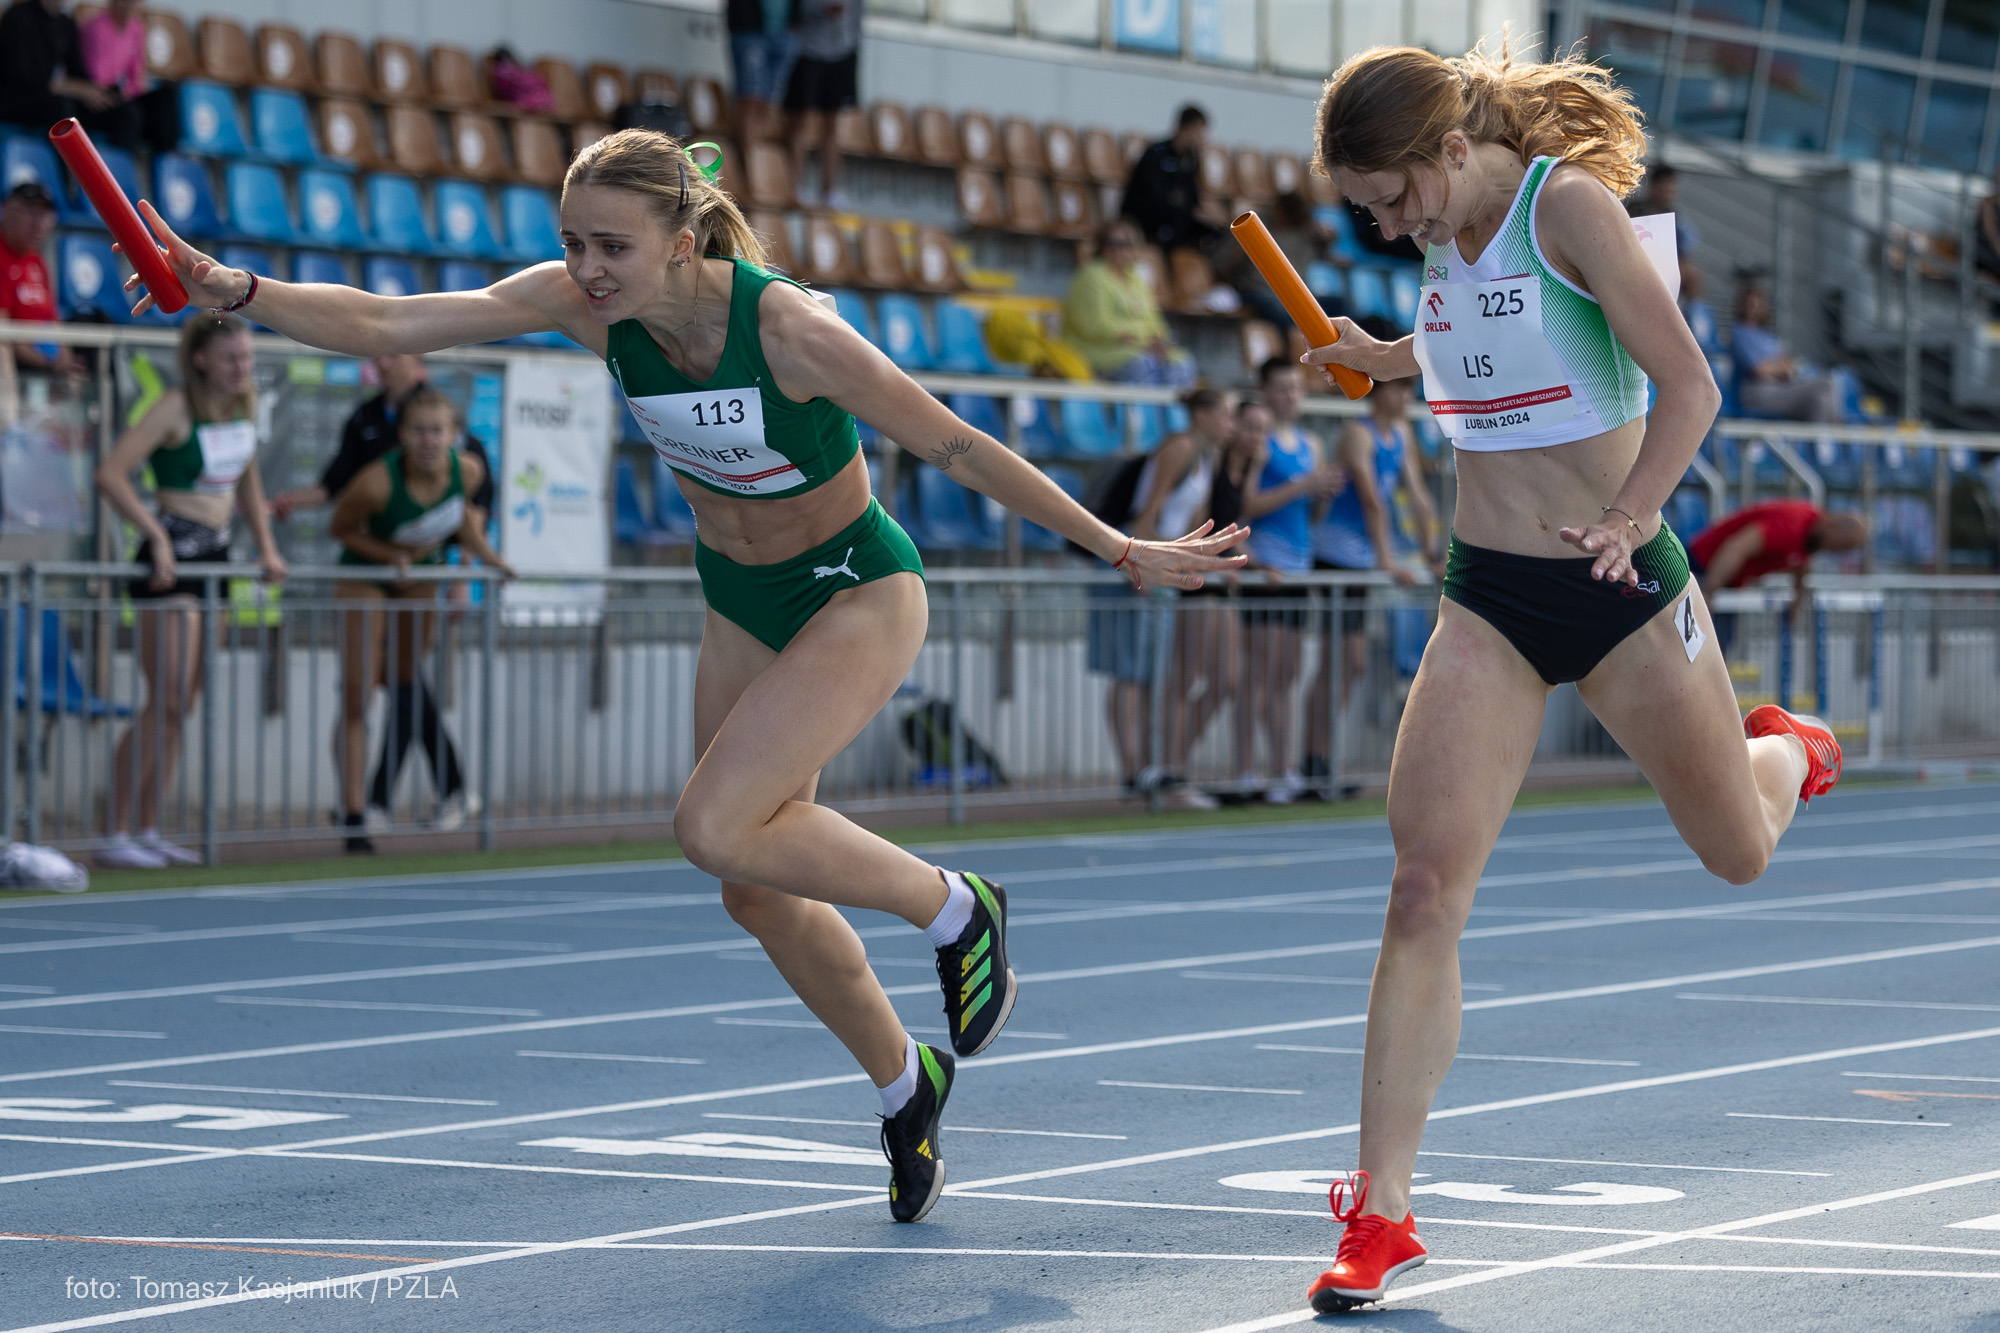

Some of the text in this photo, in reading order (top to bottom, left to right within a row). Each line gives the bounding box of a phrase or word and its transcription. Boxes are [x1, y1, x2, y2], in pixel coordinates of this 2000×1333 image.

[1477, 289, 1524, 318] 225
[1425, 321, 1452, 332] ORLEN
[1462, 354, 1494, 379] LIS
[1493, 396, 1529, 410] SZTAFETACH
[1529, 389, 1567, 402] MIESZANYCH
[691, 398, 745, 426] 113
[1464, 411, 1531, 429] LUBLIN 2024
[650, 431, 755, 464] GREINER
[692, 467, 757, 491] LUBLIN 2024
